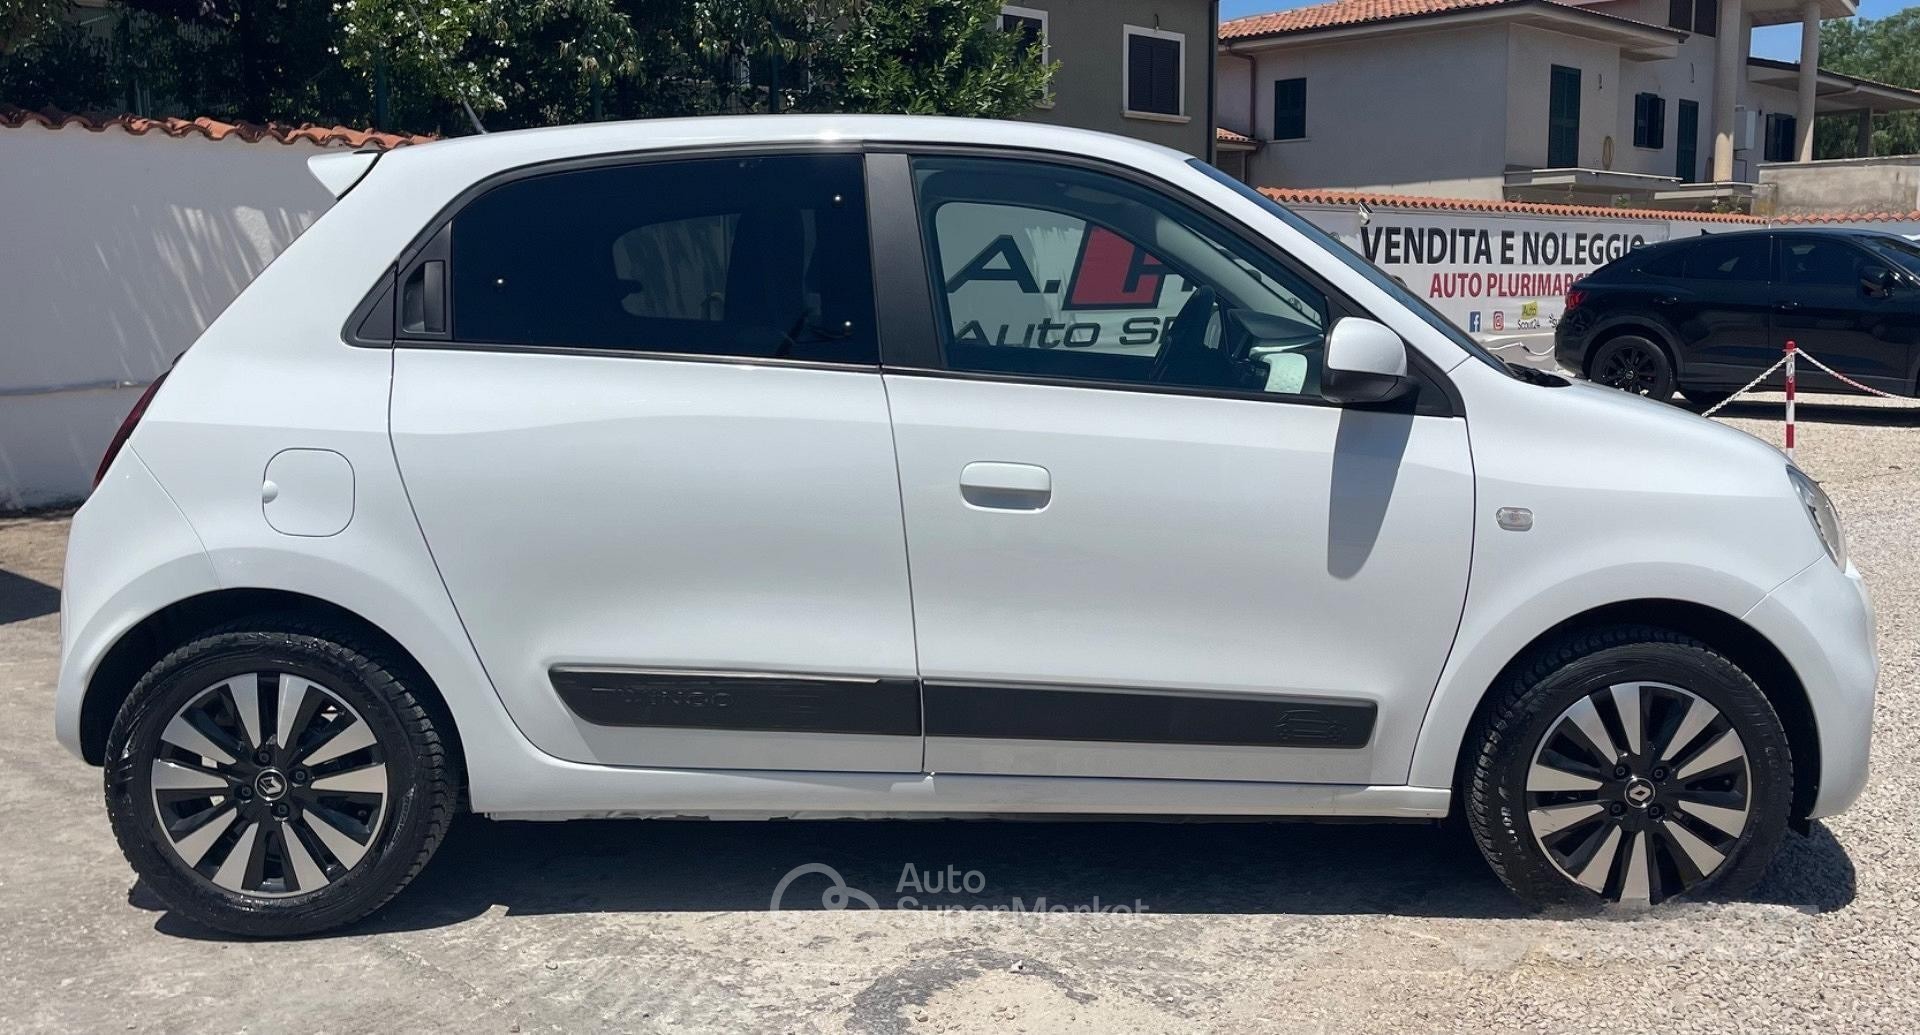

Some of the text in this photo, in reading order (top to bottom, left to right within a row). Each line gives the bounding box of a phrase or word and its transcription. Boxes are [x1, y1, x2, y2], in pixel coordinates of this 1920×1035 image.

[1361, 226, 1492, 265] VENDITA
[1501, 231, 1515, 265] E
[1429, 272, 1482, 299] AUTO
[954, 317, 1100, 349] Auto
